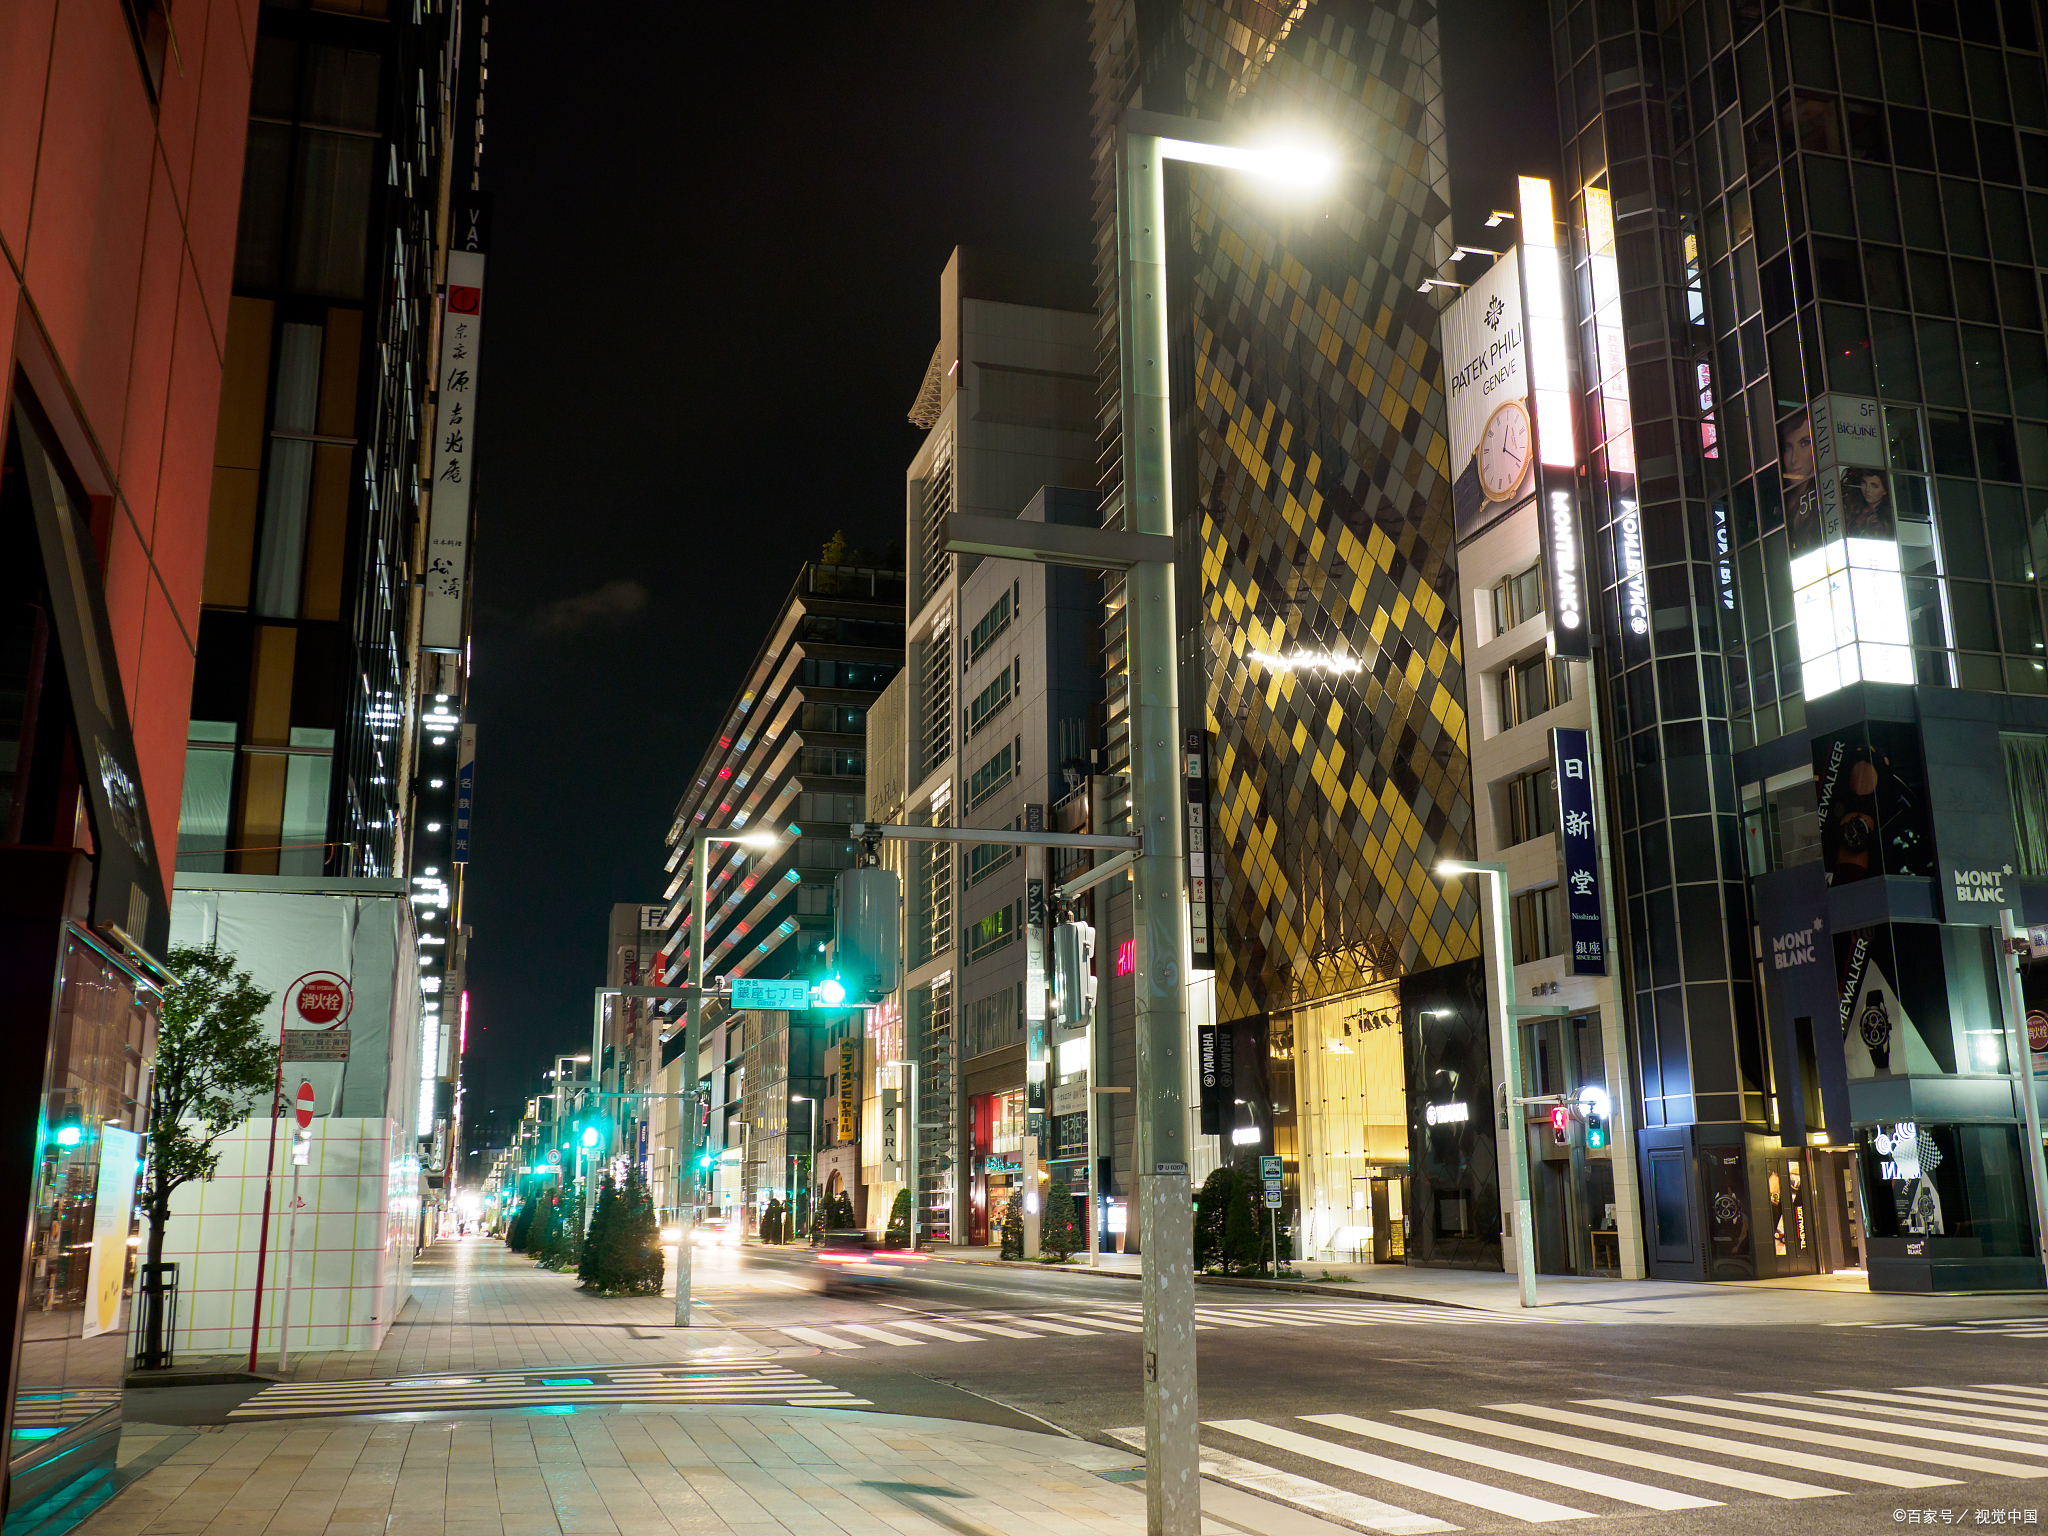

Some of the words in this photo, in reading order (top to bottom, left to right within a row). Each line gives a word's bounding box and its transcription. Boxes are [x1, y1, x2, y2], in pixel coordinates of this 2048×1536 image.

[1452, 350, 1488, 398] PATEK
[1482, 358, 1516, 396] GENEVE
[1860, 403, 1876, 416] 5F
[1814, 406, 1830, 460] HAIR
[1837, 424, 1878, 438] BIGUINE
[1800, 490, 1816, 515] 5F
[1822, 478, 1836, 515] SPA
[1828, 518, 1839, 534] 5F
[456, 778, 472, 850] 名鉄観光
[1564, 758, 1594, 895] 日新堂
[1954, 870, 2002, 886] MONT
[1028, 884, 1042, 923] ダンス
[1956, 886, 2005, 902] BLANC
[1572, 912, 1600, 920] Nisshindo
[1576, 940, 1600, 954] 銀座
[1772, 928, 1812, 952] MONT
[1030, 949, 1042, 968] Dr.
[1774, 946, 1816, 970] BLANC
[300, 992, 340, 1010] 消火栓
[737, 986, 804, 1000] 銀座七丁目
[1202, 1032, 1215, 1074] YAMAHA
[884, 1108, 895, 1162] ZARA
